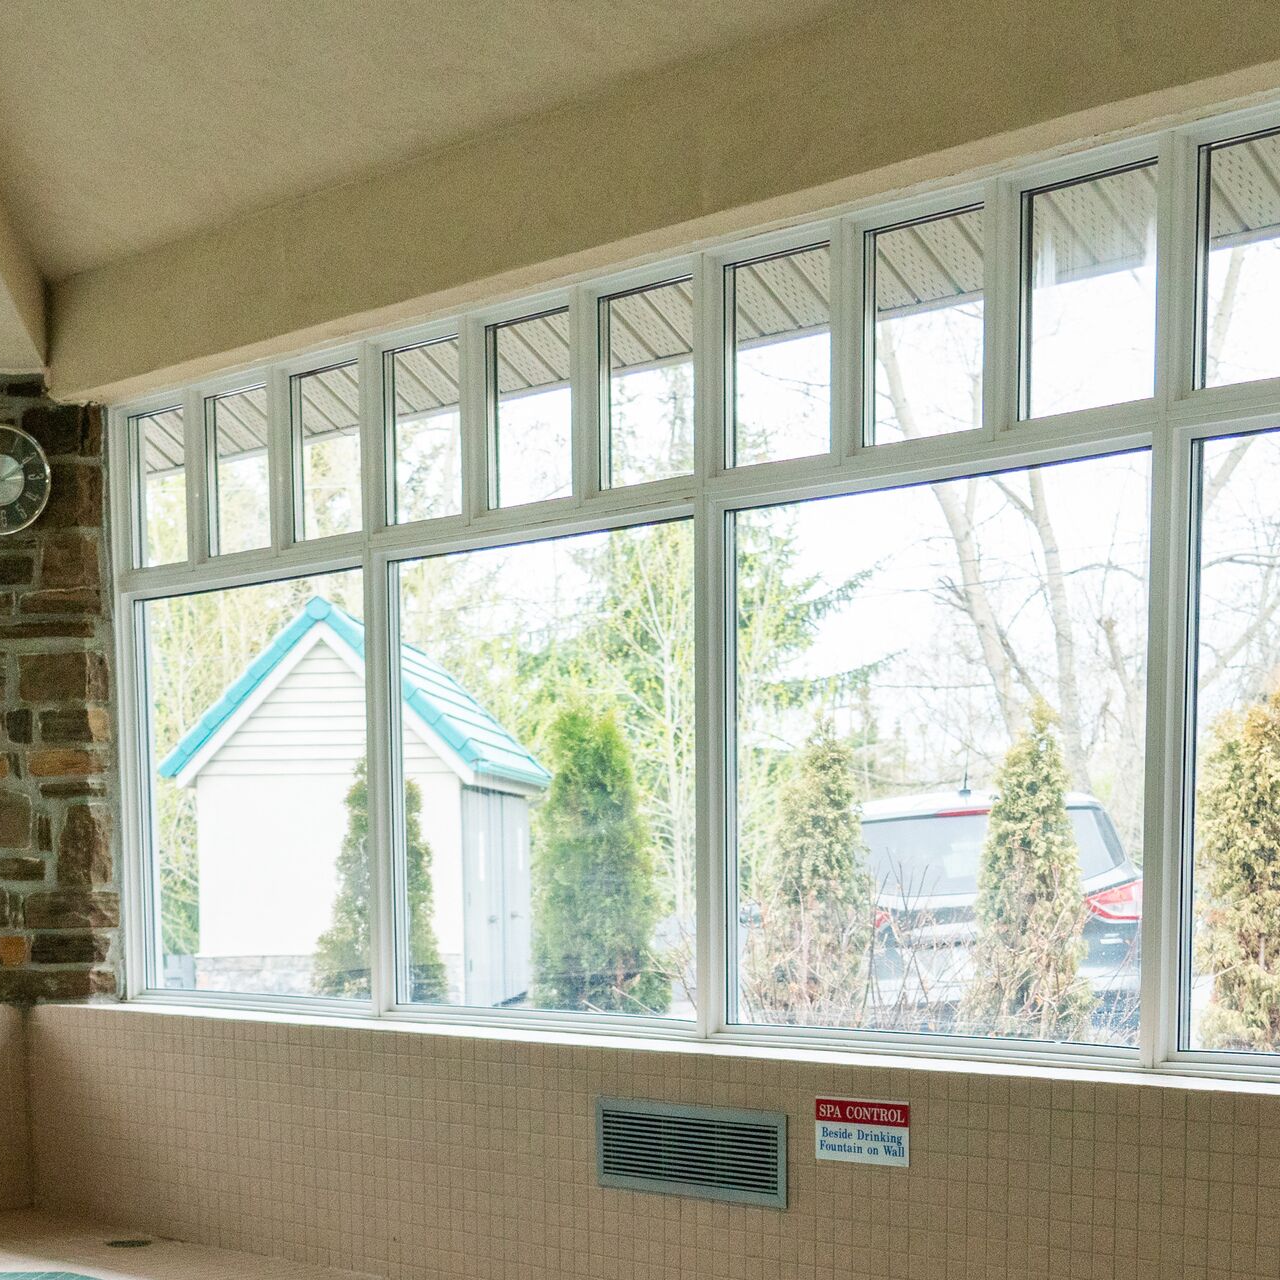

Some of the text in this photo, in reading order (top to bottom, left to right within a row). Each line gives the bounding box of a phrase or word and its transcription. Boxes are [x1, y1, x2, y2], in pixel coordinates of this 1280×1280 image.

[819, 1104, 905, 1123] SPA CONTROL
[822, 1126, 903, 1146] Beside Drinking
[819, 1139, 905, 1157] Fountain on Wall
